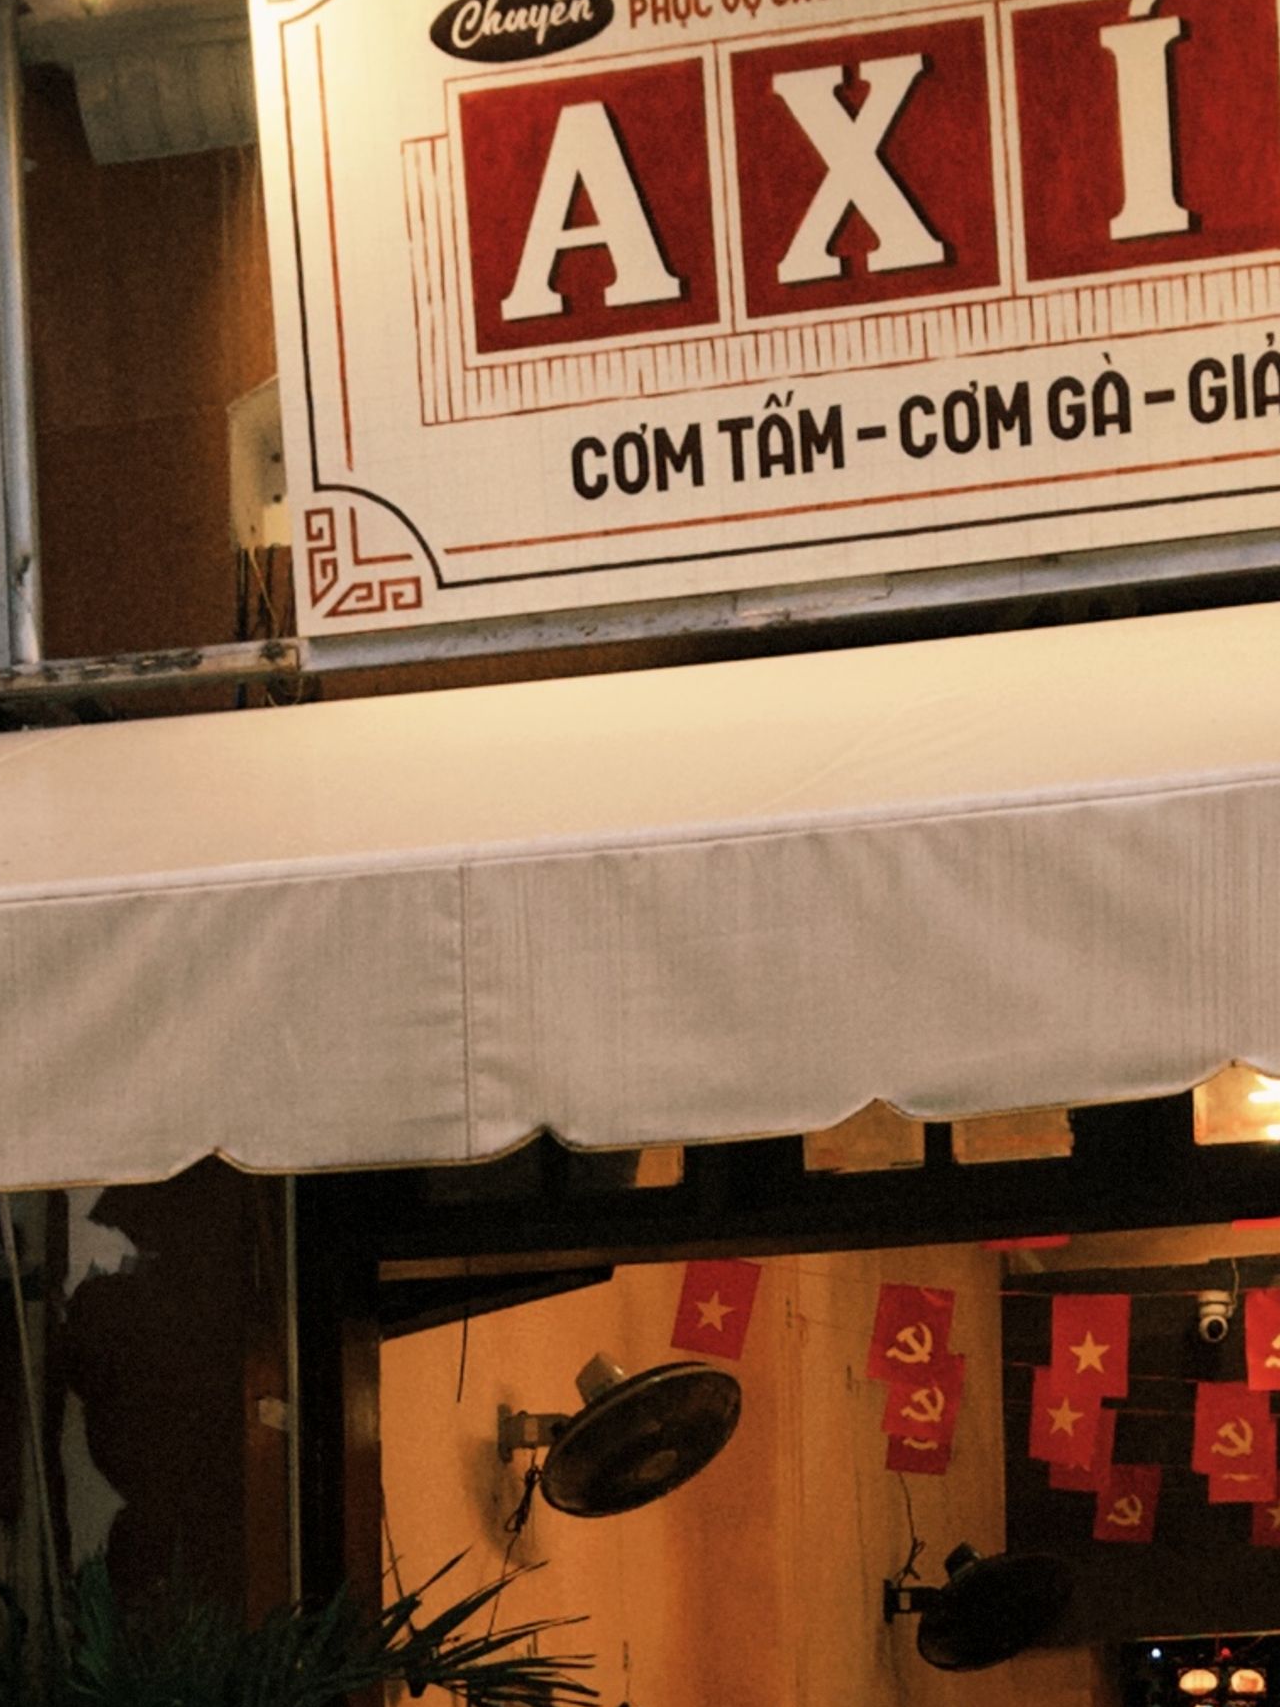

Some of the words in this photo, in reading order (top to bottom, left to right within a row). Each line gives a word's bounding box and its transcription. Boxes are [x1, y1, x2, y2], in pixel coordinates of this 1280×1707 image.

[572, 420, 704, 501] CƠM
[718, 391, 845, 482] TẤM
[899, 378, 1032, 459] CƠM
[1047, 350, 1132, 441] GÀ
